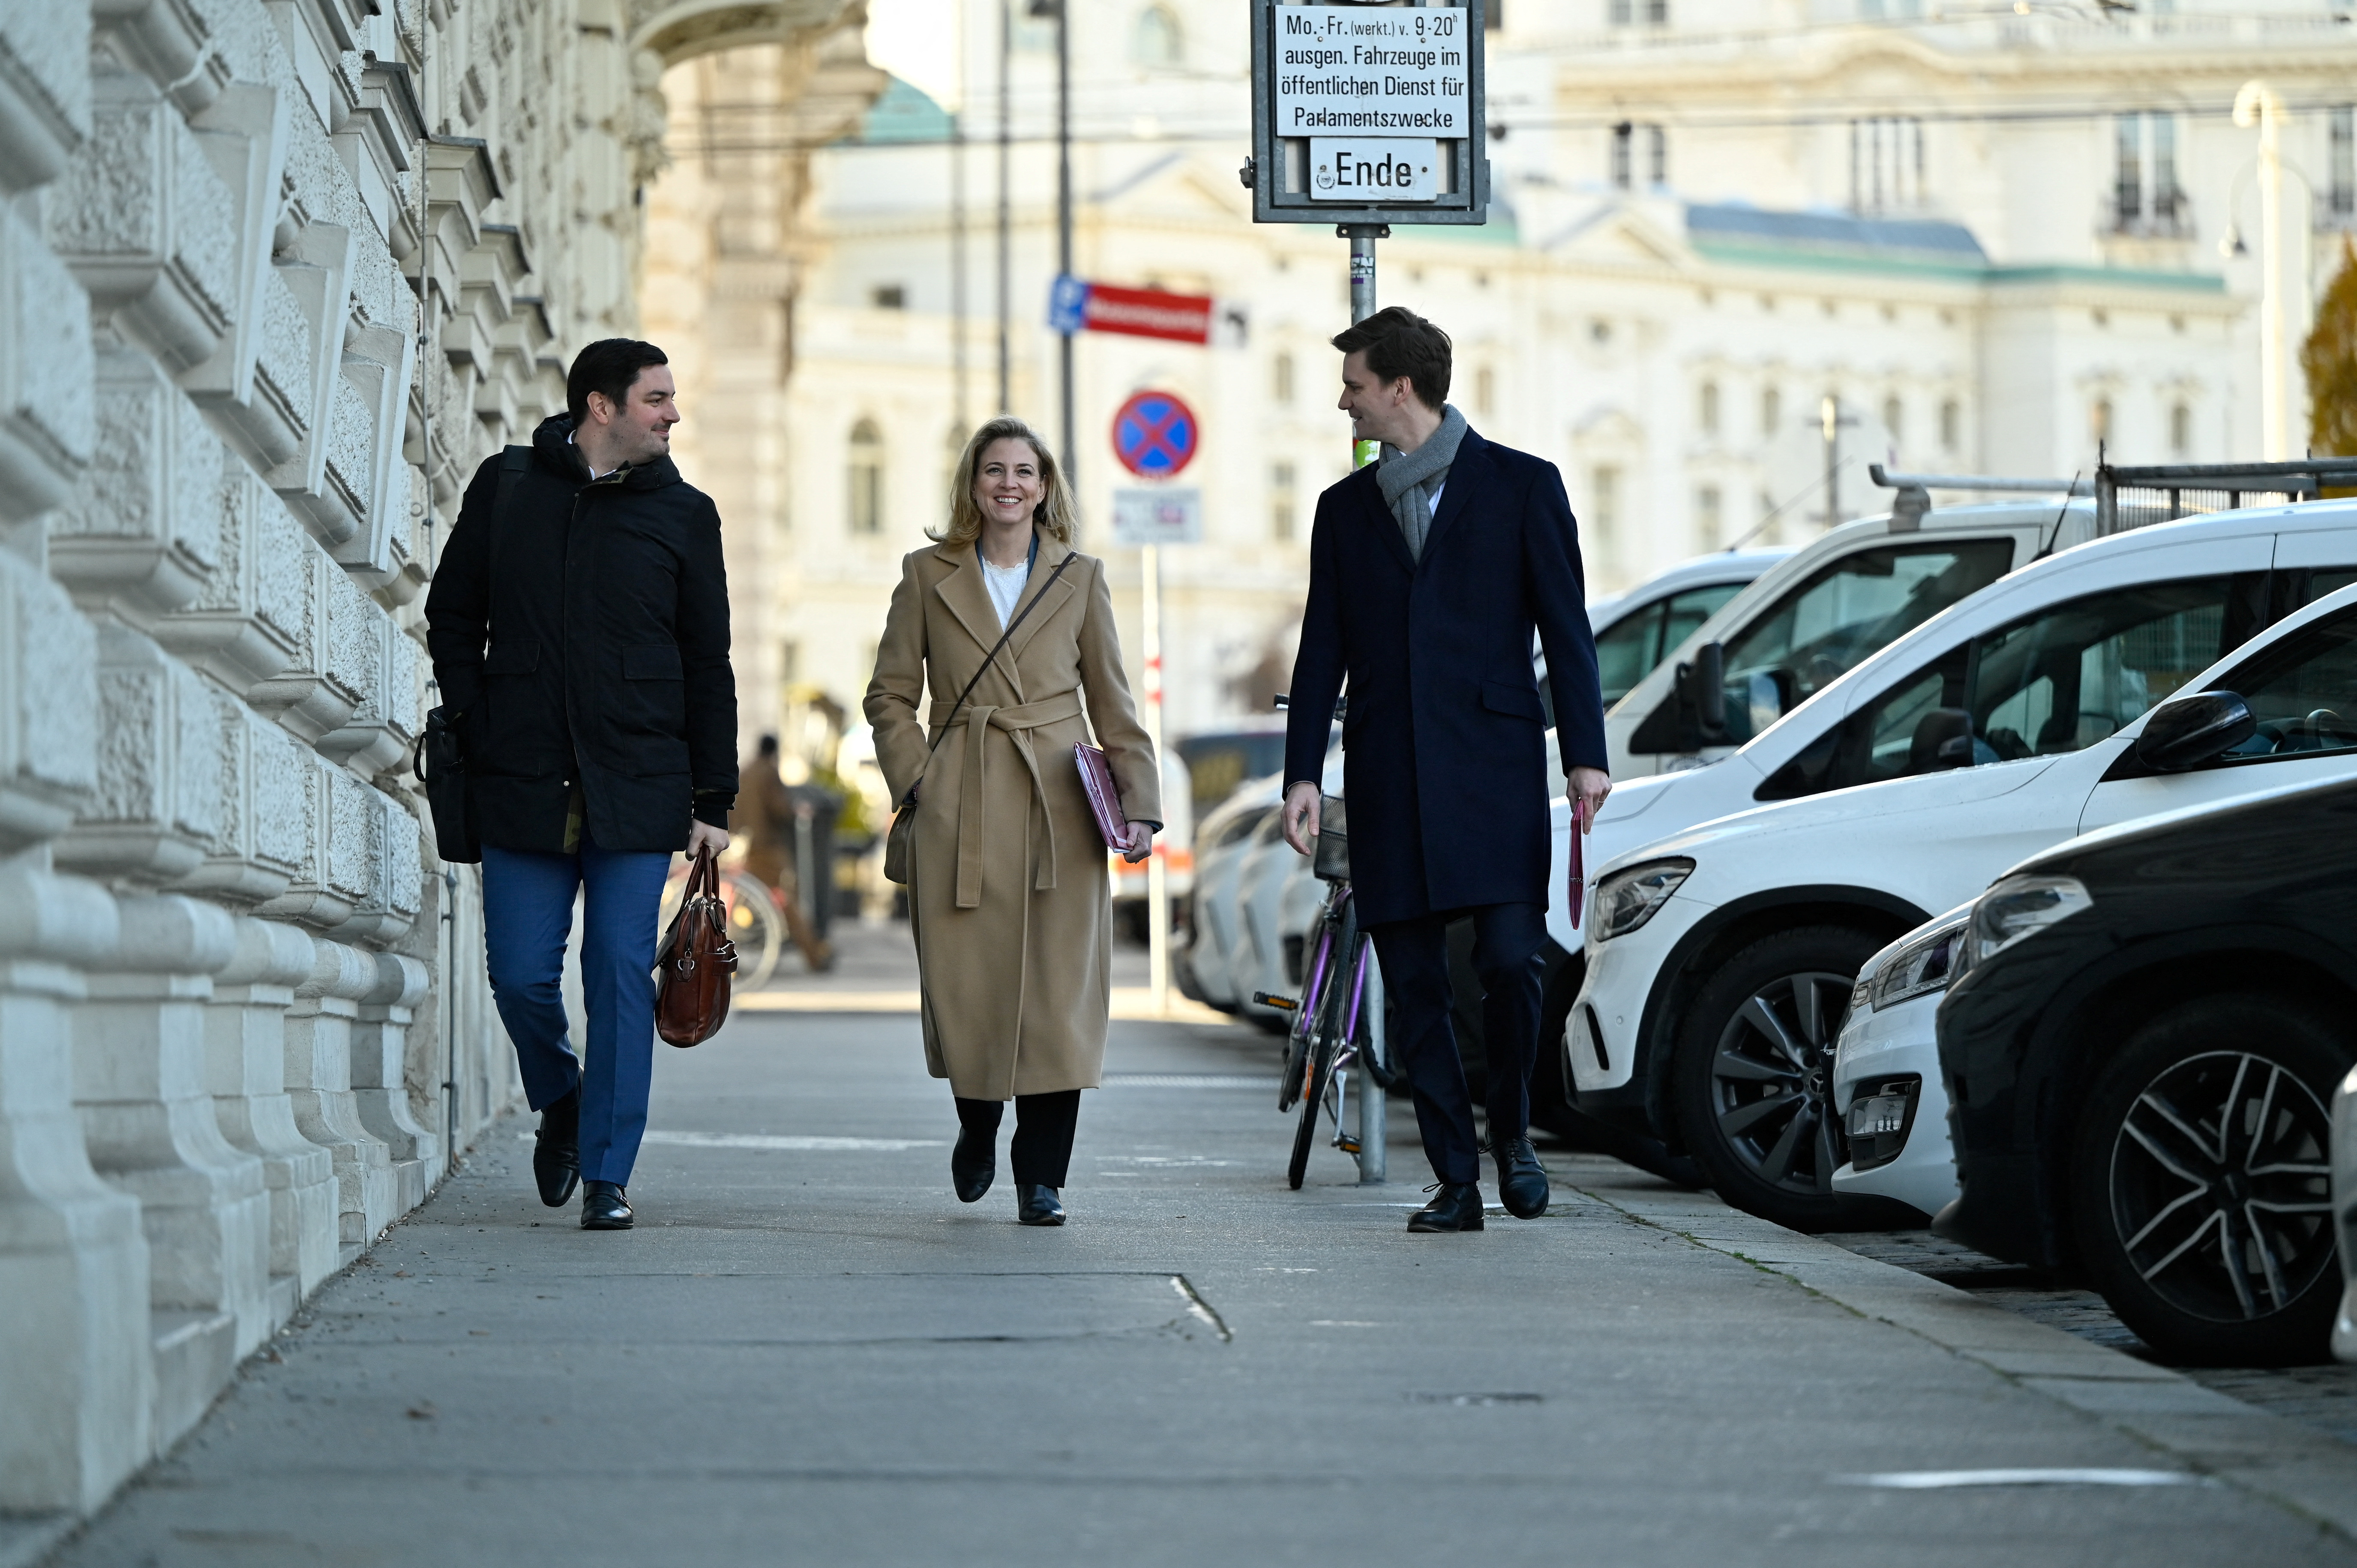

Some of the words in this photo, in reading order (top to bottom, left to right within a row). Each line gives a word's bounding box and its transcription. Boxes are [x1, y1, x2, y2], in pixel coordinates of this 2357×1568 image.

[1351, 20, 1394, 36] (werkt.)
[1399, 25, 1409, 36] v.
[1285, 50, 1347, 69] ausgen.
[1354, 45, 1436, 70] Fahrzeuge
[1441, 46, 1460, 66] im
[1282, 75, 1378, 95] öffentlichen
[1385, 76, 1435, 96] Dienst
[1441, 76, 1464, 96] für
[1295, 107, 1452, 128] Parlamentszwecke
[1337, 152, 1411, 187] Ende
